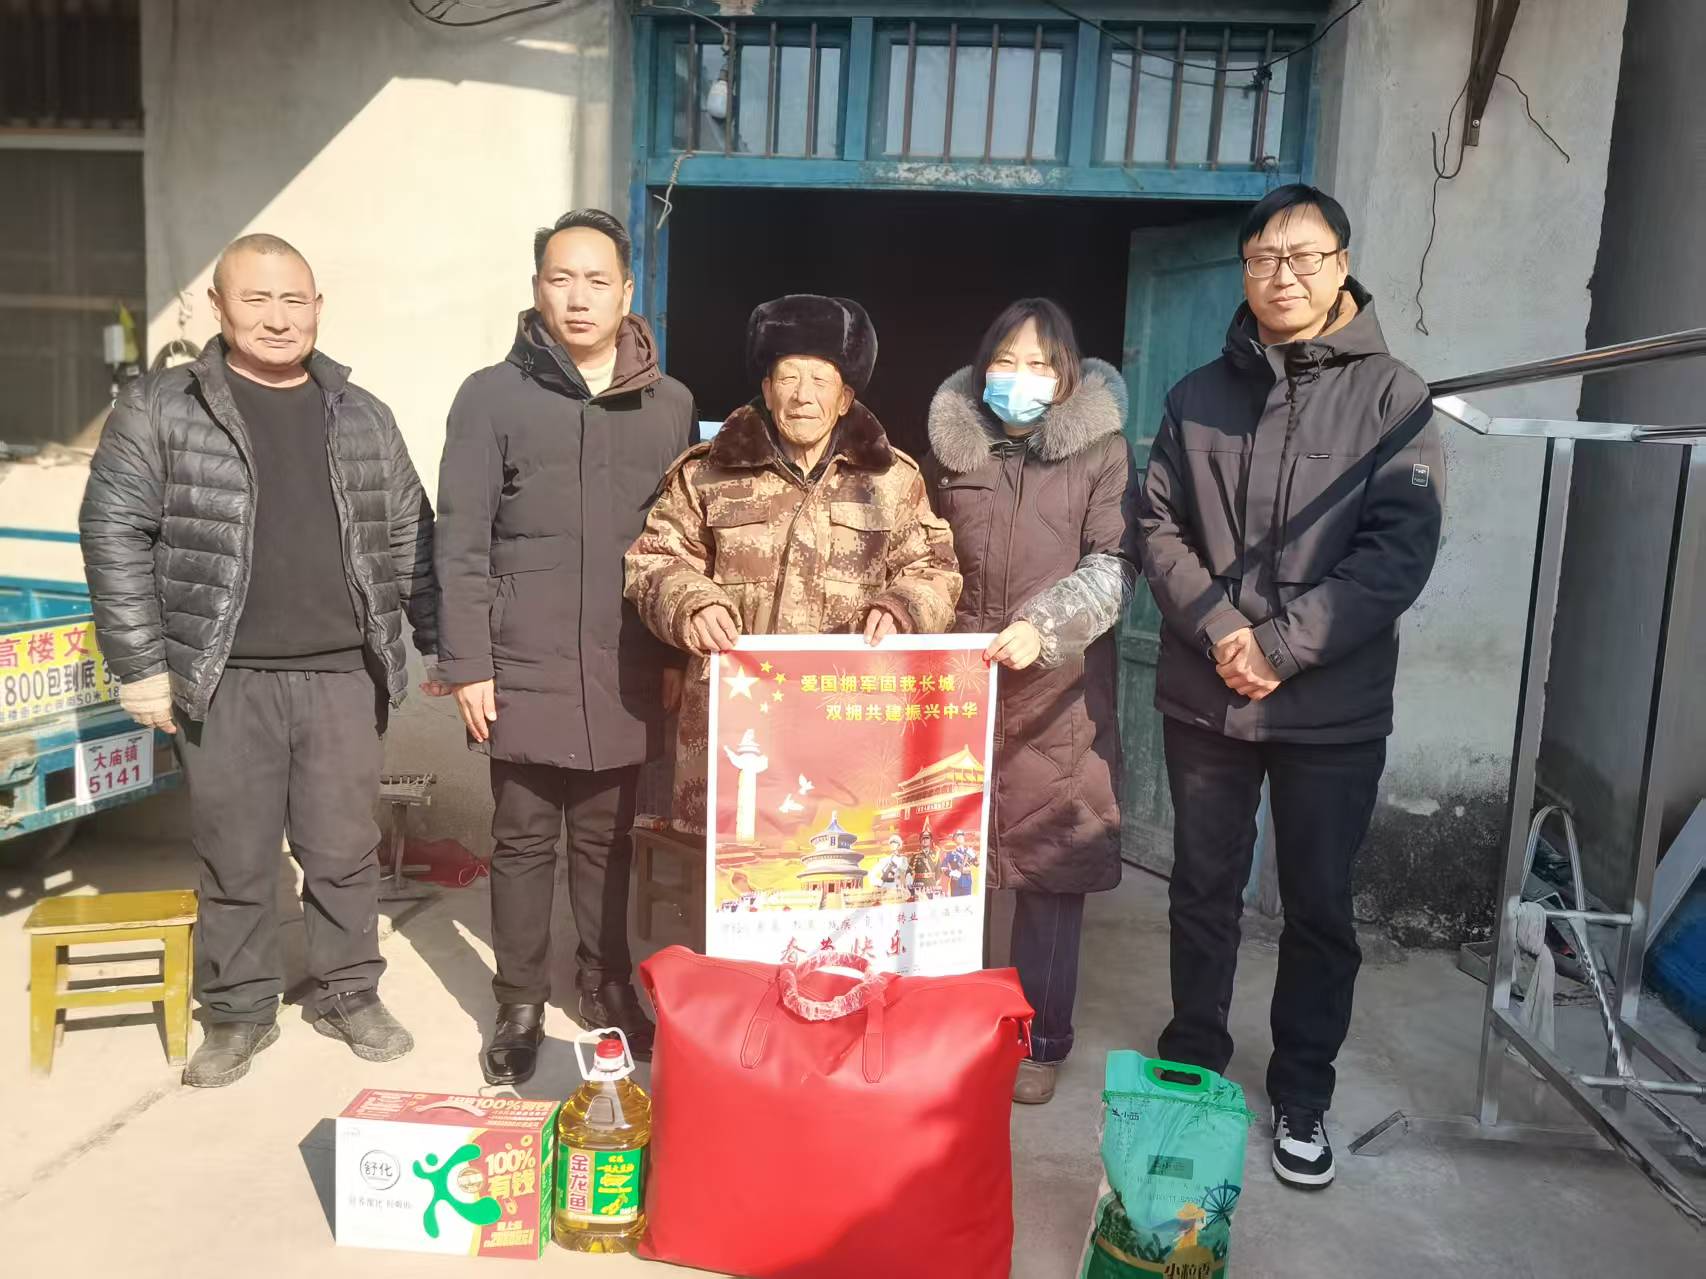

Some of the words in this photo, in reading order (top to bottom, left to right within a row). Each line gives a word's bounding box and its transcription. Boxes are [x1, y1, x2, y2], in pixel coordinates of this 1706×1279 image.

[5, 659, 97, 706] 800包到底
[800, 674, 956, 693] 爱国拥军固我长城
[826, 702, 978, 722] 双拥共建振兴中华
[94, 744, 139, 771] 大庙镇
[88, 764, 141, 794] 5141
[364, 1160, 393, 1178] 舒化
[485, 1148, 536, 1176] 100%
[569, 1153, 590, 1212] 金龙鱼
